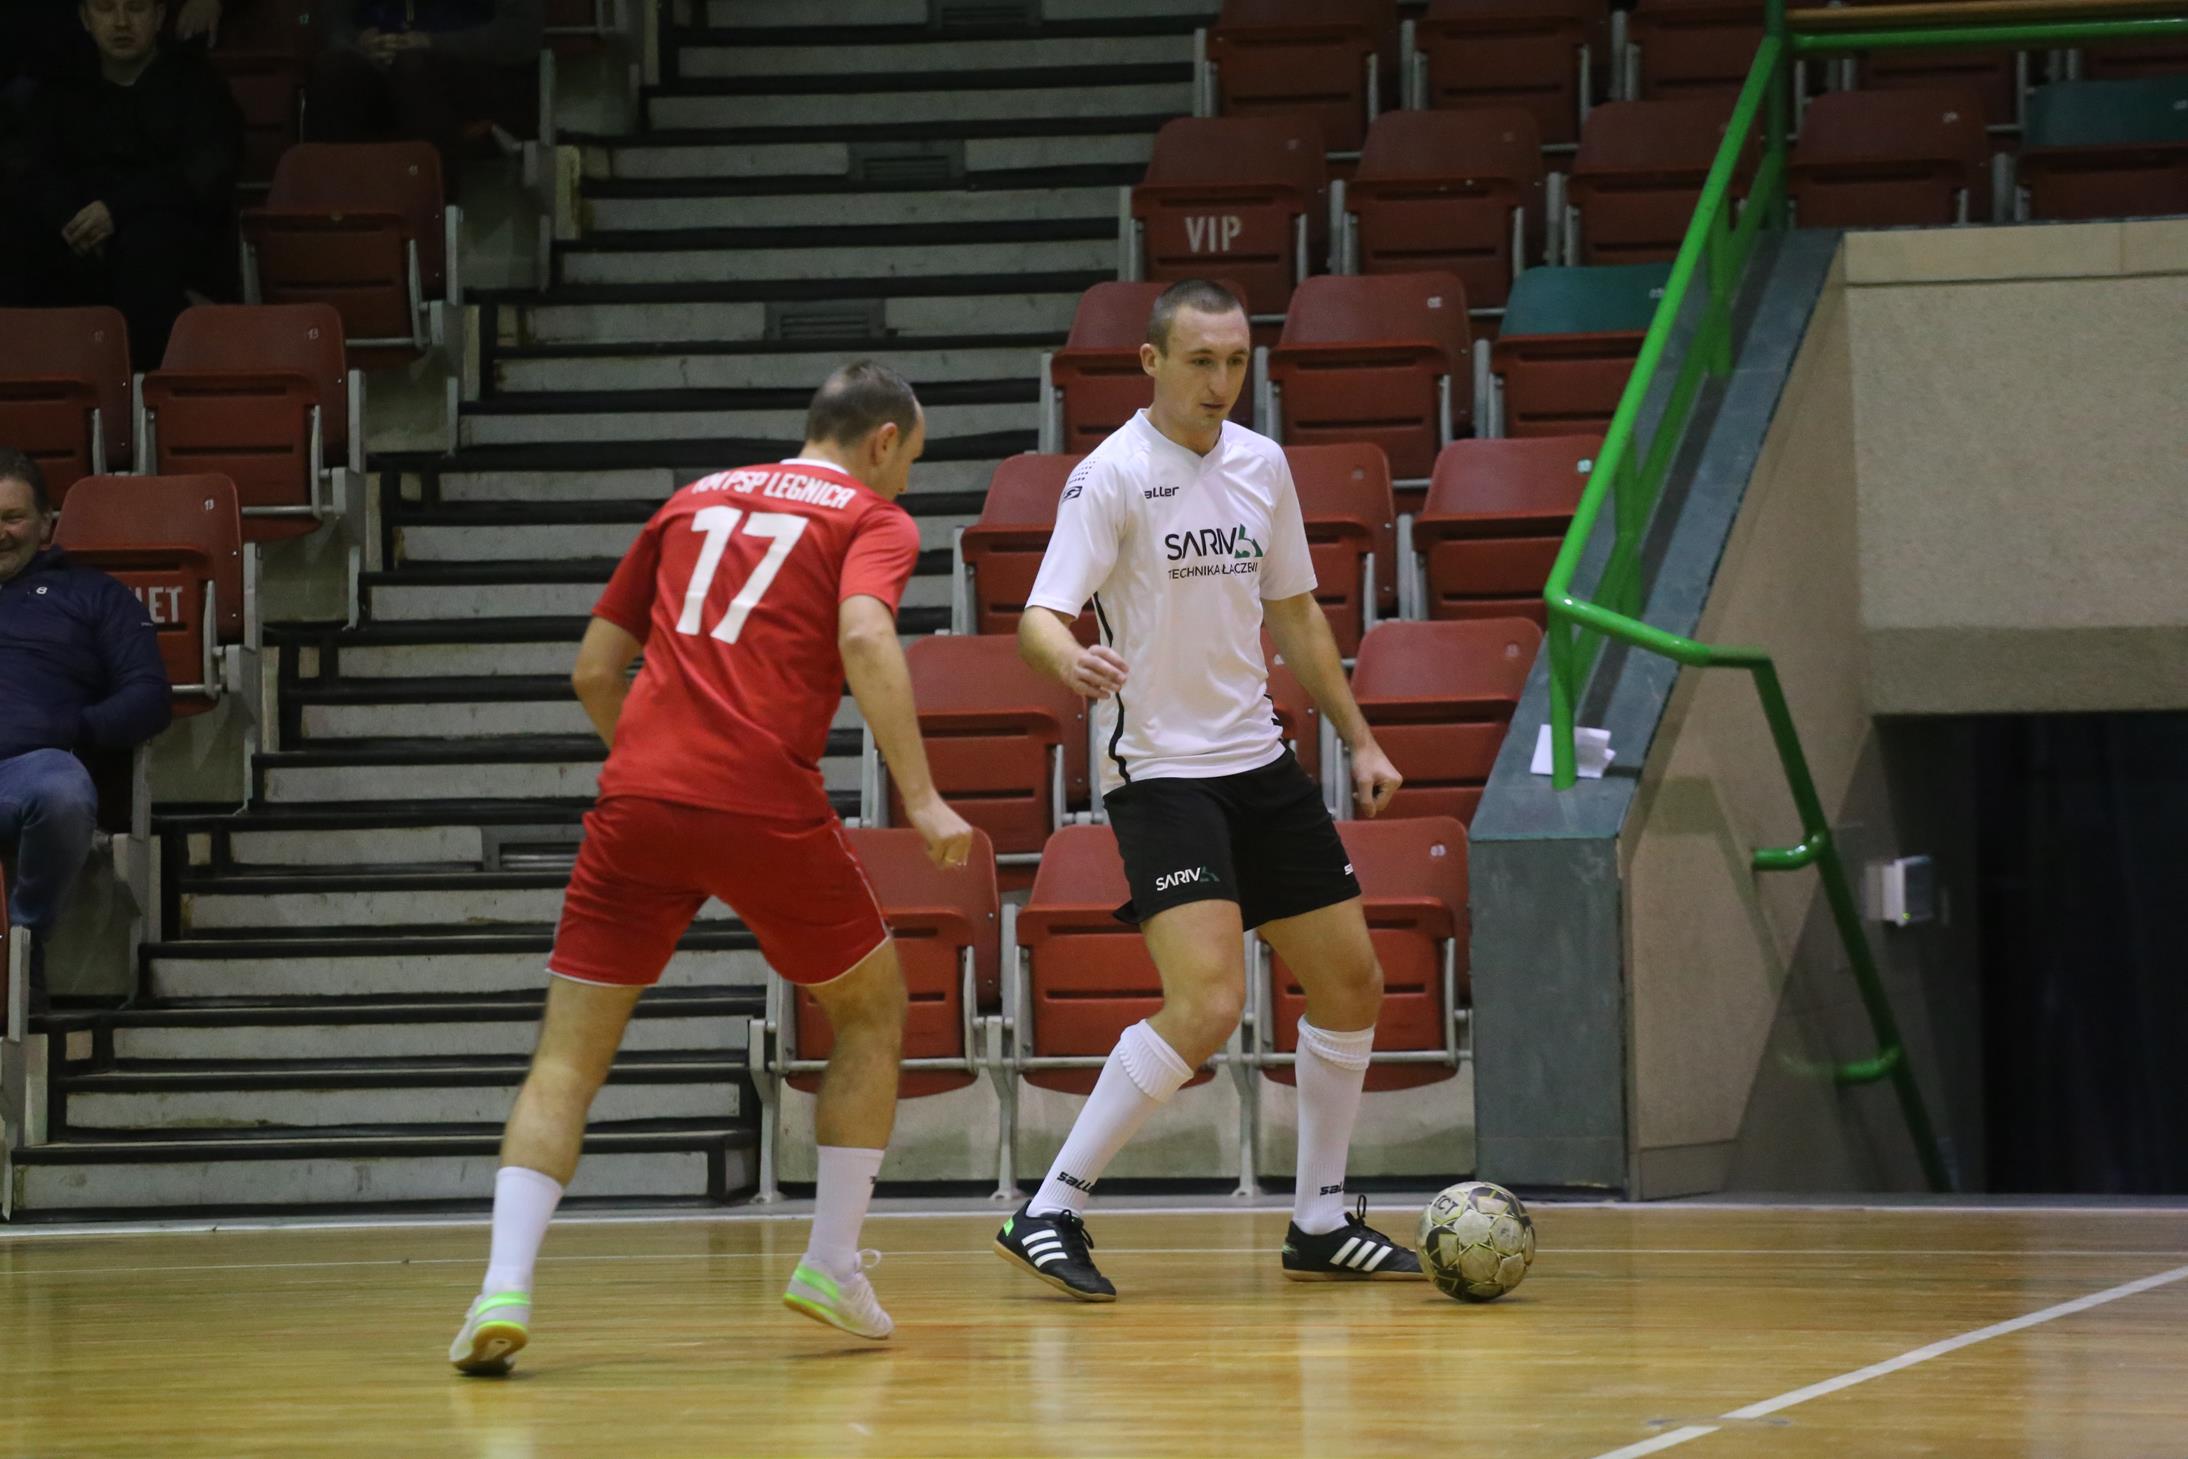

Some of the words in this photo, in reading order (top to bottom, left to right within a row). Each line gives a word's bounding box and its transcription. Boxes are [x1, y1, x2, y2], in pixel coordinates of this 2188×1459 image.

[1184, 215, 1242, 252] VIP
[763, 471, 857, 509] LEGNICA
[675, 505, 810, 645] 17
[1168, 563, 1220, 580] TECHNIKA
[1057, 1171, 1095, 1195] sall
